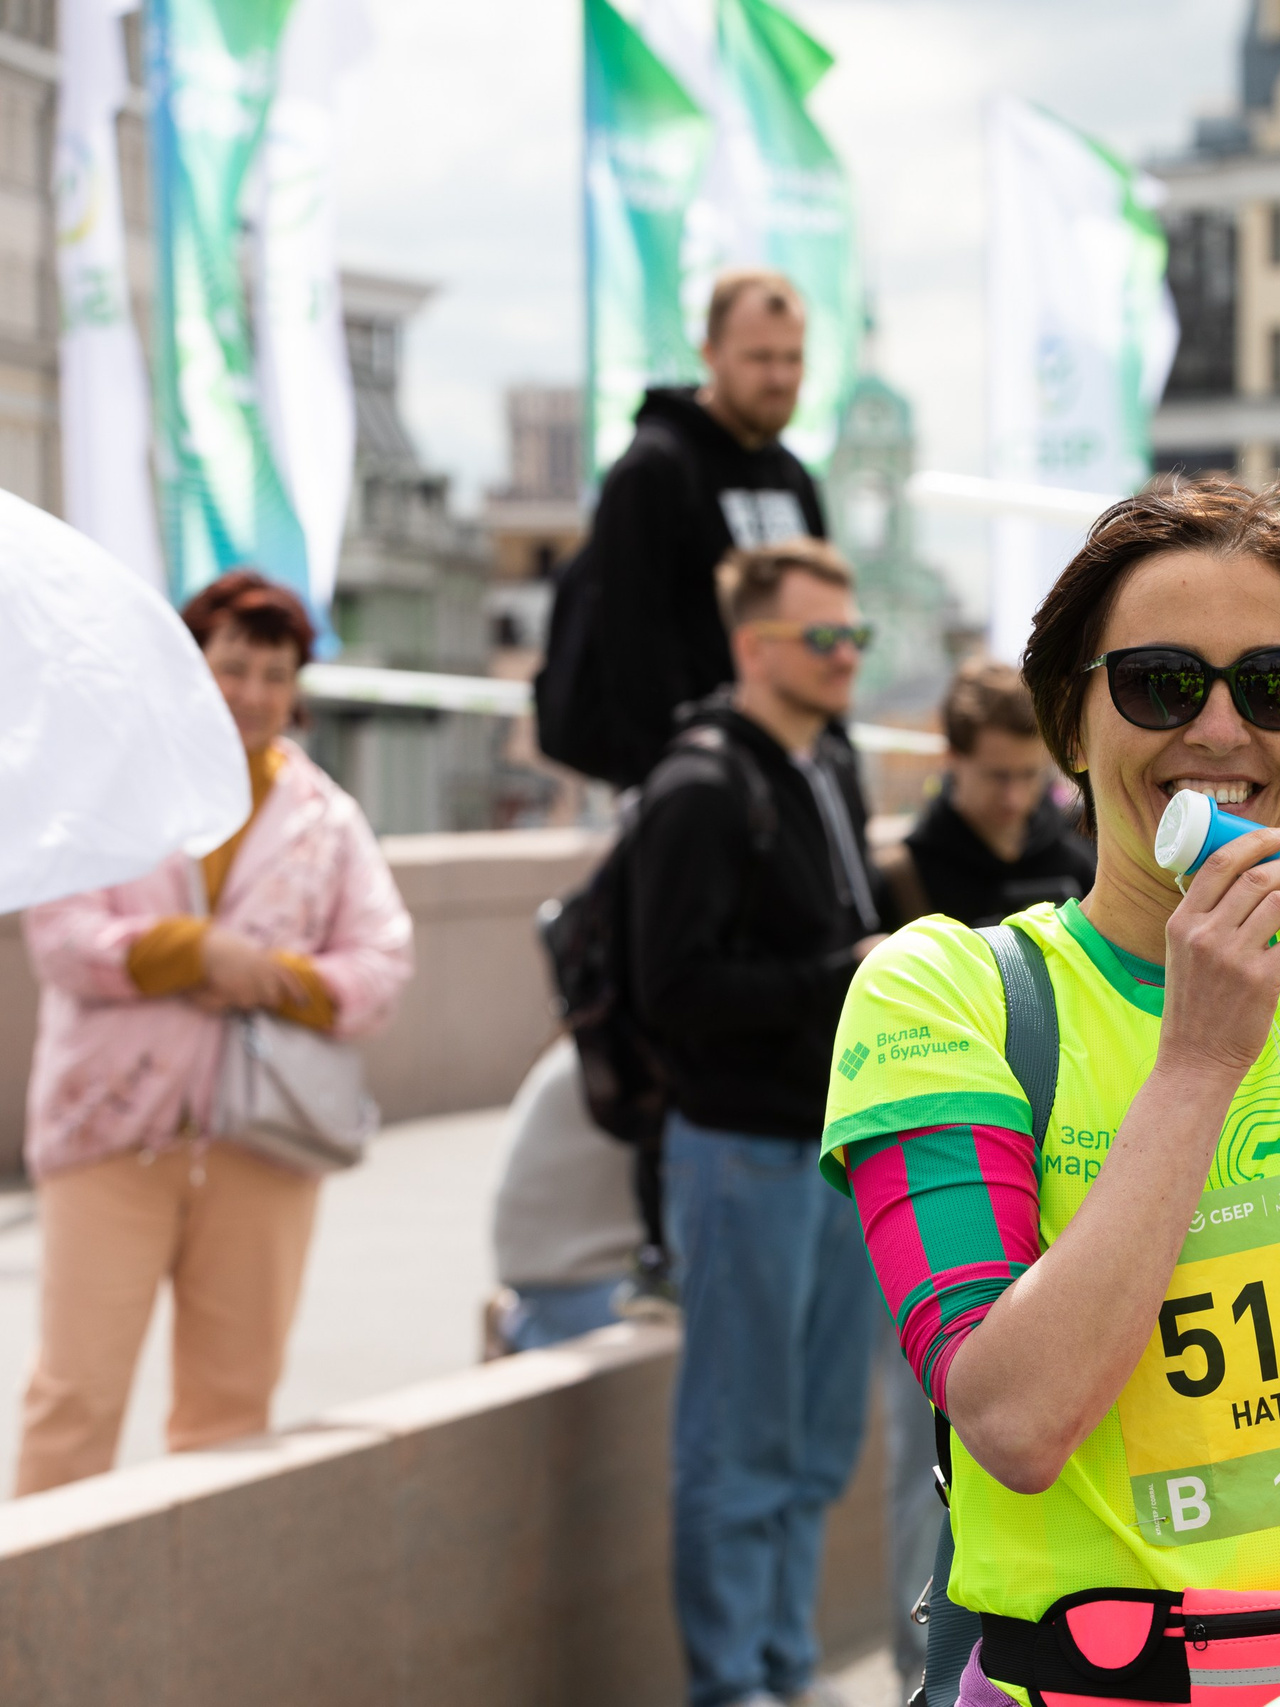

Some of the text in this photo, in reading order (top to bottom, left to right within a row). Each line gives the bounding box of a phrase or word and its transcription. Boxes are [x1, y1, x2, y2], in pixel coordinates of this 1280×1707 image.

[877, 1026, 931, 1047] Вклад
[878, 1040, 969, 1064] в будущее
[1061, 1126, 1118, 1150] зел
[1210, 1202, 1254, 1224] СБЕР
